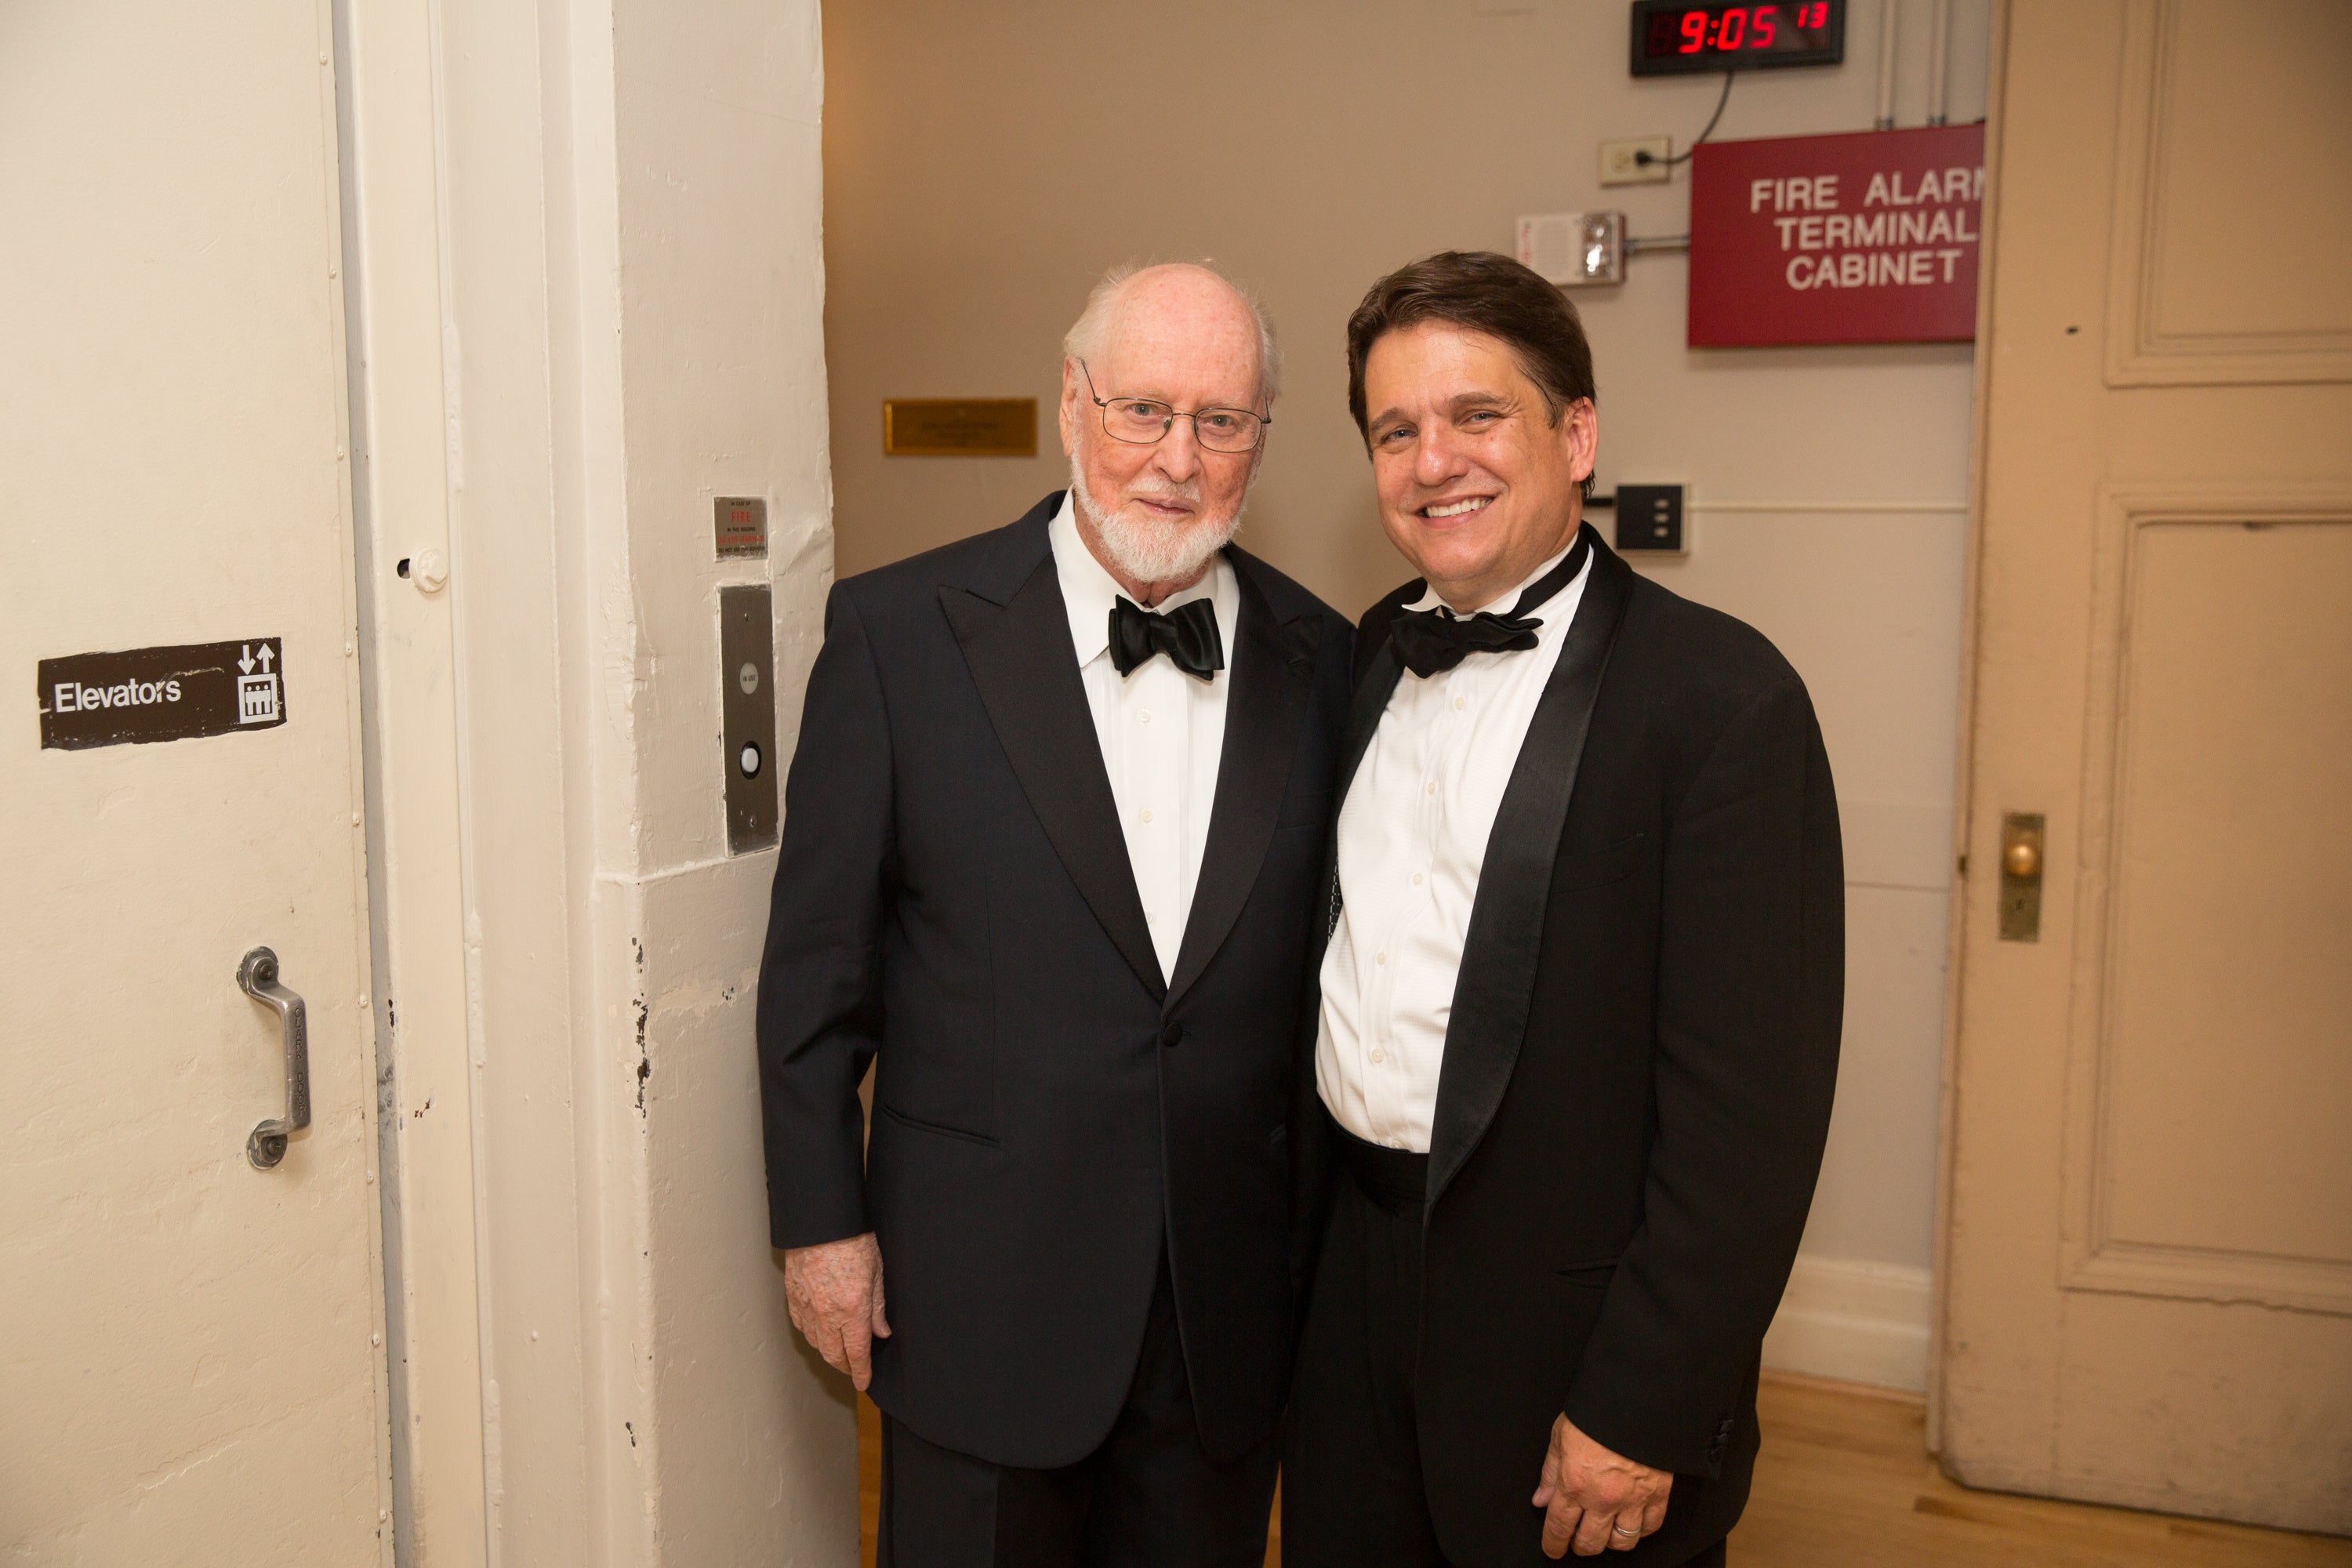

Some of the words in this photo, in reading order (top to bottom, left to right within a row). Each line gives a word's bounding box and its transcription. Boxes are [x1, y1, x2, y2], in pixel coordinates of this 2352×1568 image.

[1679, 6, 1777, 53] 9:05
[1798, 2, 1828, 28] 13
[1750, 175, 1839, 213] FIRE
[1773, 208, 1979, 251] TERMINAL
[1786, 248, 1963, 291] CABINET
[731, 510, 750, 522] FIRE
[54, 677, 182, 713] Elevators
[294, 1007, 303, 1059] CLARK
[297, 1072, 307, 1117] DOOR
